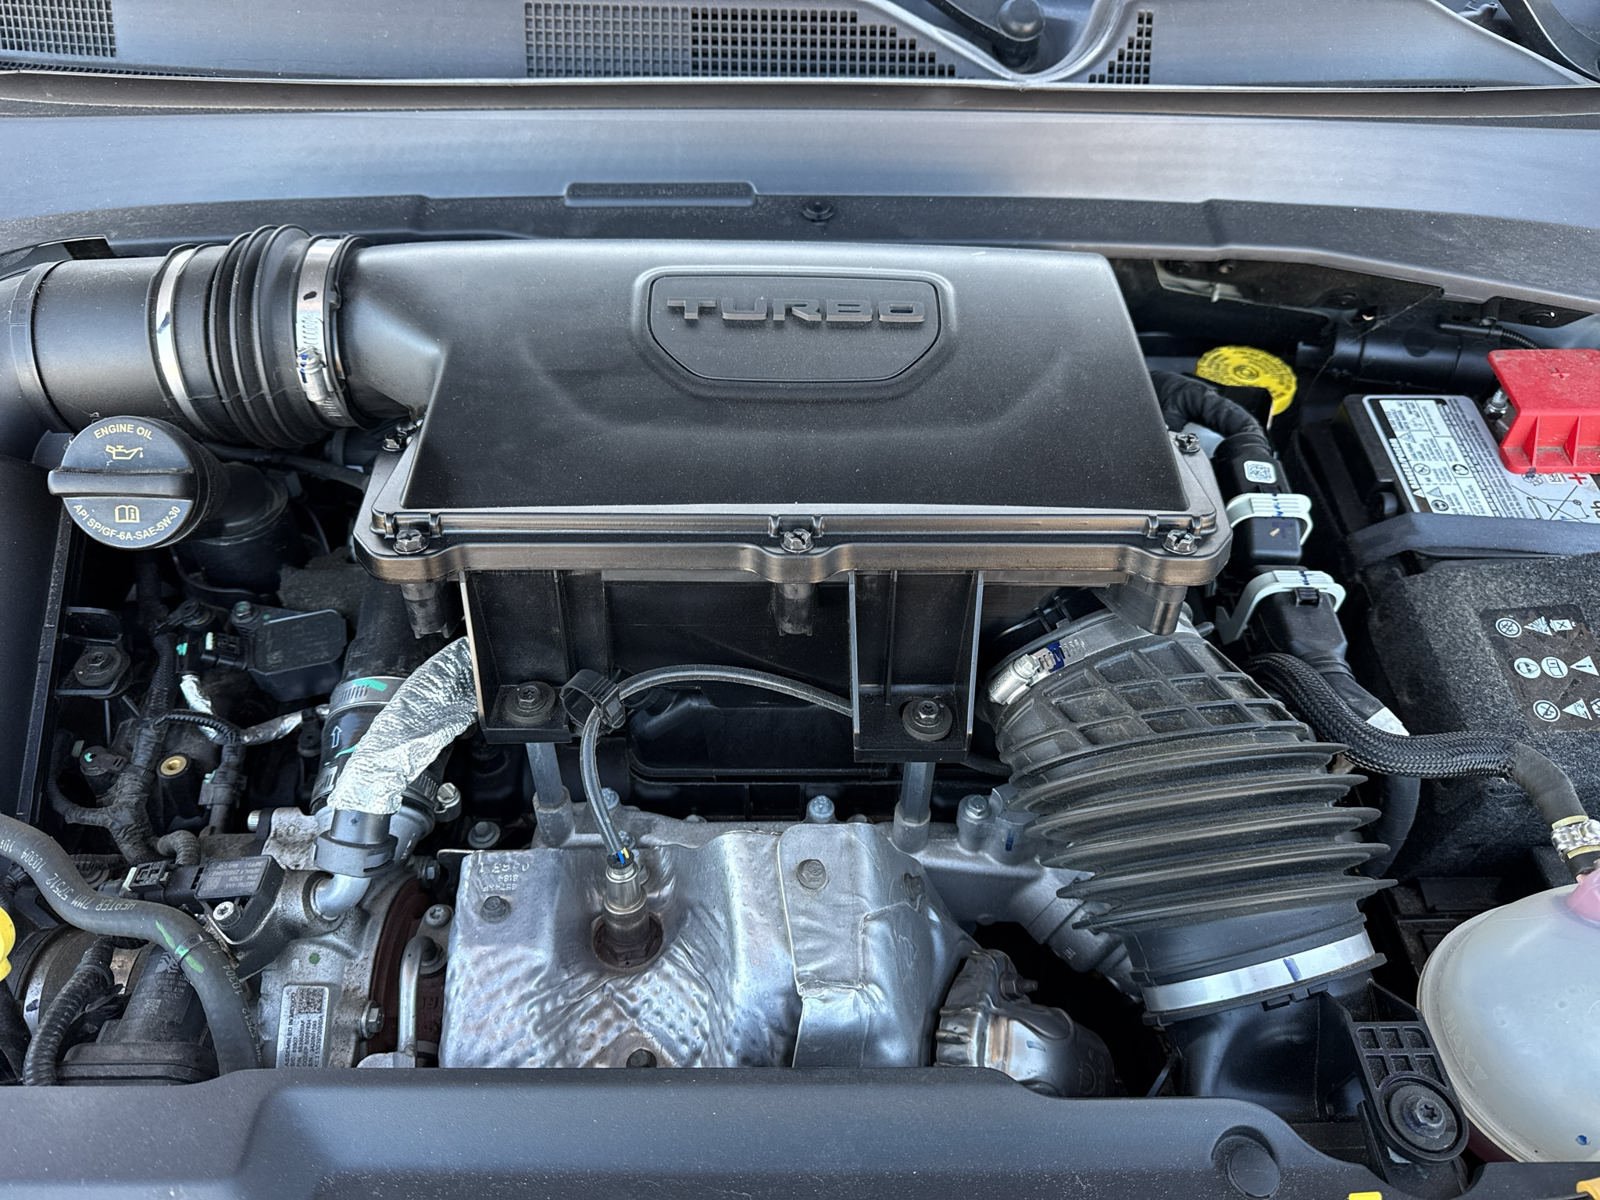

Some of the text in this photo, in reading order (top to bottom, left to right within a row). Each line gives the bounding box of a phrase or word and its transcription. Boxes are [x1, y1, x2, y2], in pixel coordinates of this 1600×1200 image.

[667, 299, 925, 323] TURBO
[94, 423, 153, 440] ENGINE OIL
[73, 504, 89, 521] API
